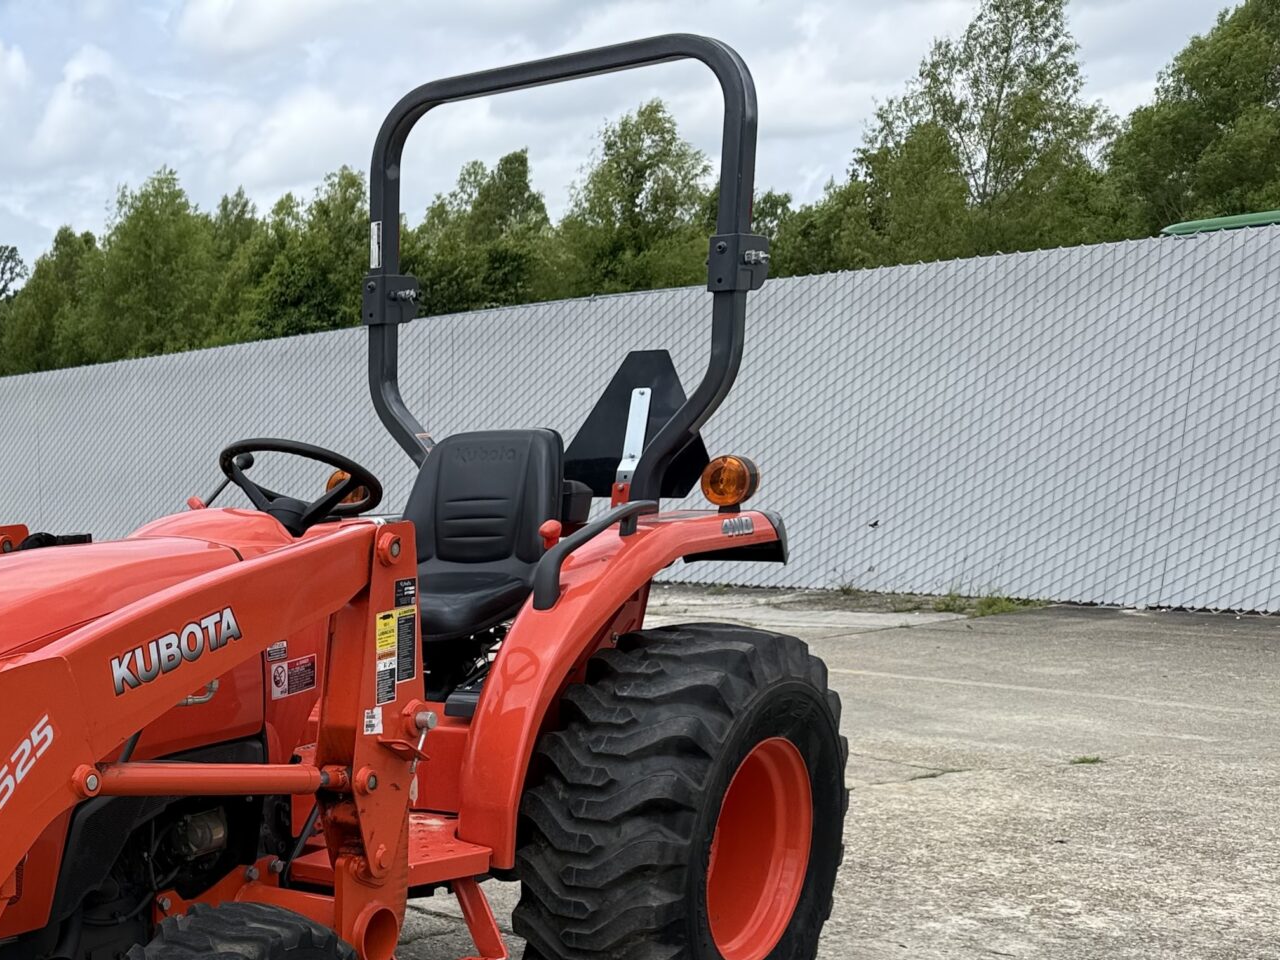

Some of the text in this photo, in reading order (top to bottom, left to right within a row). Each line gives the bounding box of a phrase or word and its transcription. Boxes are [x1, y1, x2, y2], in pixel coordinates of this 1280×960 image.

[455, 445, 517, 464] Kubota
[721, 516, 754, 537] 4WD
[110, 606, 242, 696] KUBOTA
